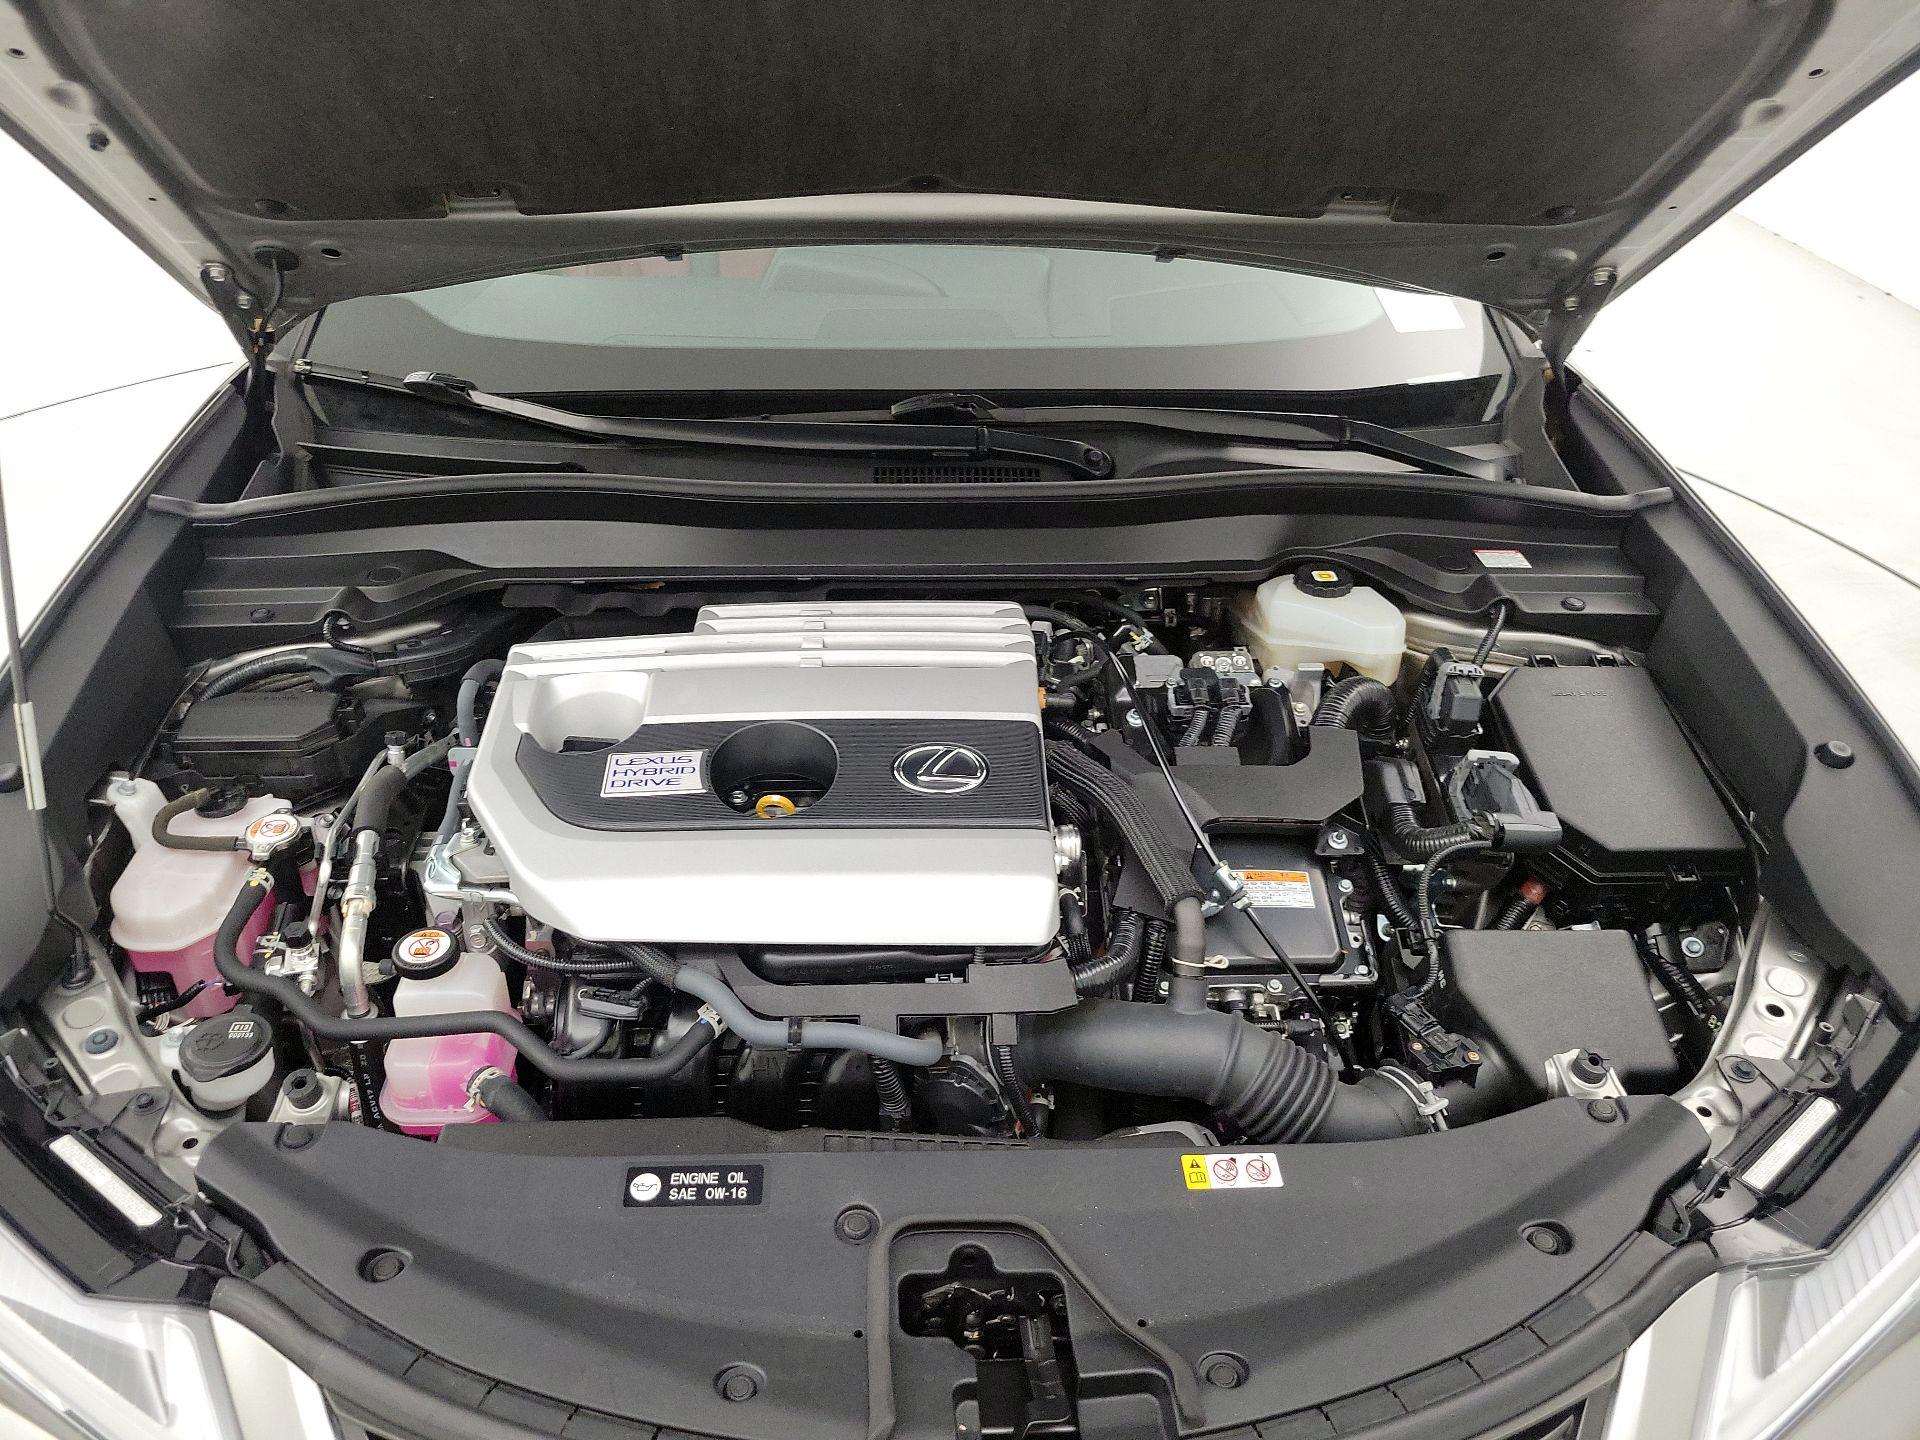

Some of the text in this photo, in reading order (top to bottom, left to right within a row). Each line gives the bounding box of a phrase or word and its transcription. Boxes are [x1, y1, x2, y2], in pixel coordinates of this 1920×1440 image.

[615, 756, 693, 766] LEXUS
[612, 766, 696, 777] HYBRID
[610, 778, 683, 788] DRIVE
[670, 1171, 749, 1185] ENGINE OIL
[668, 1187, 748, 1200] SAE 0W-16
